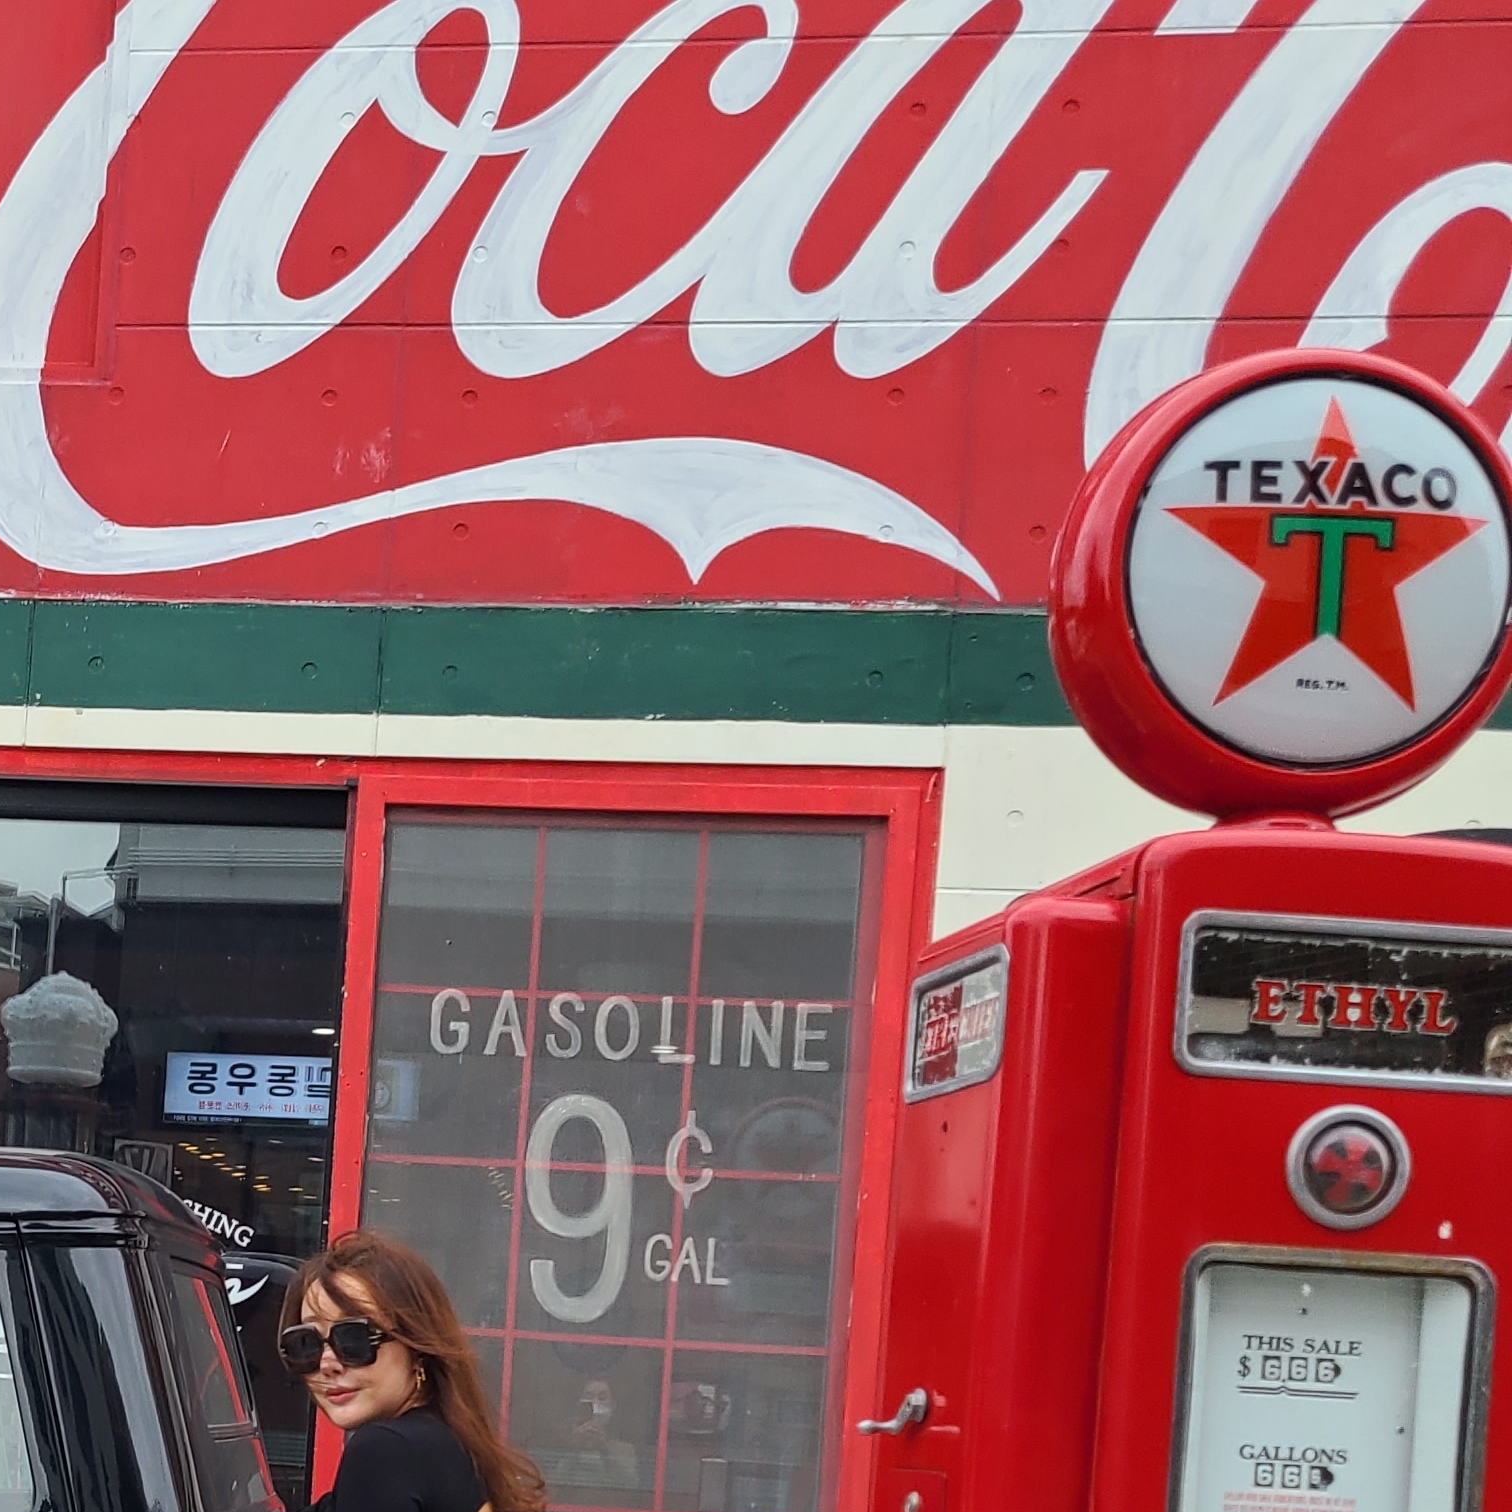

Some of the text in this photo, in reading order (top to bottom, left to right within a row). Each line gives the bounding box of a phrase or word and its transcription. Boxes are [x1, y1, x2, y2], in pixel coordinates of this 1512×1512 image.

[1203, 458, 1458, 510] TEXACO
[429, 987, 833, 1072] GASOLINE
[1251, 978, 1457, 1035] ETHYL
[183, 1199, 255, 1248] HING
[644, 1232, 730, 1286] GAL
[1242, 1334, 1363, 1357] THIS SALE
[1239, 1444, 1348, 1465] GALLONS
